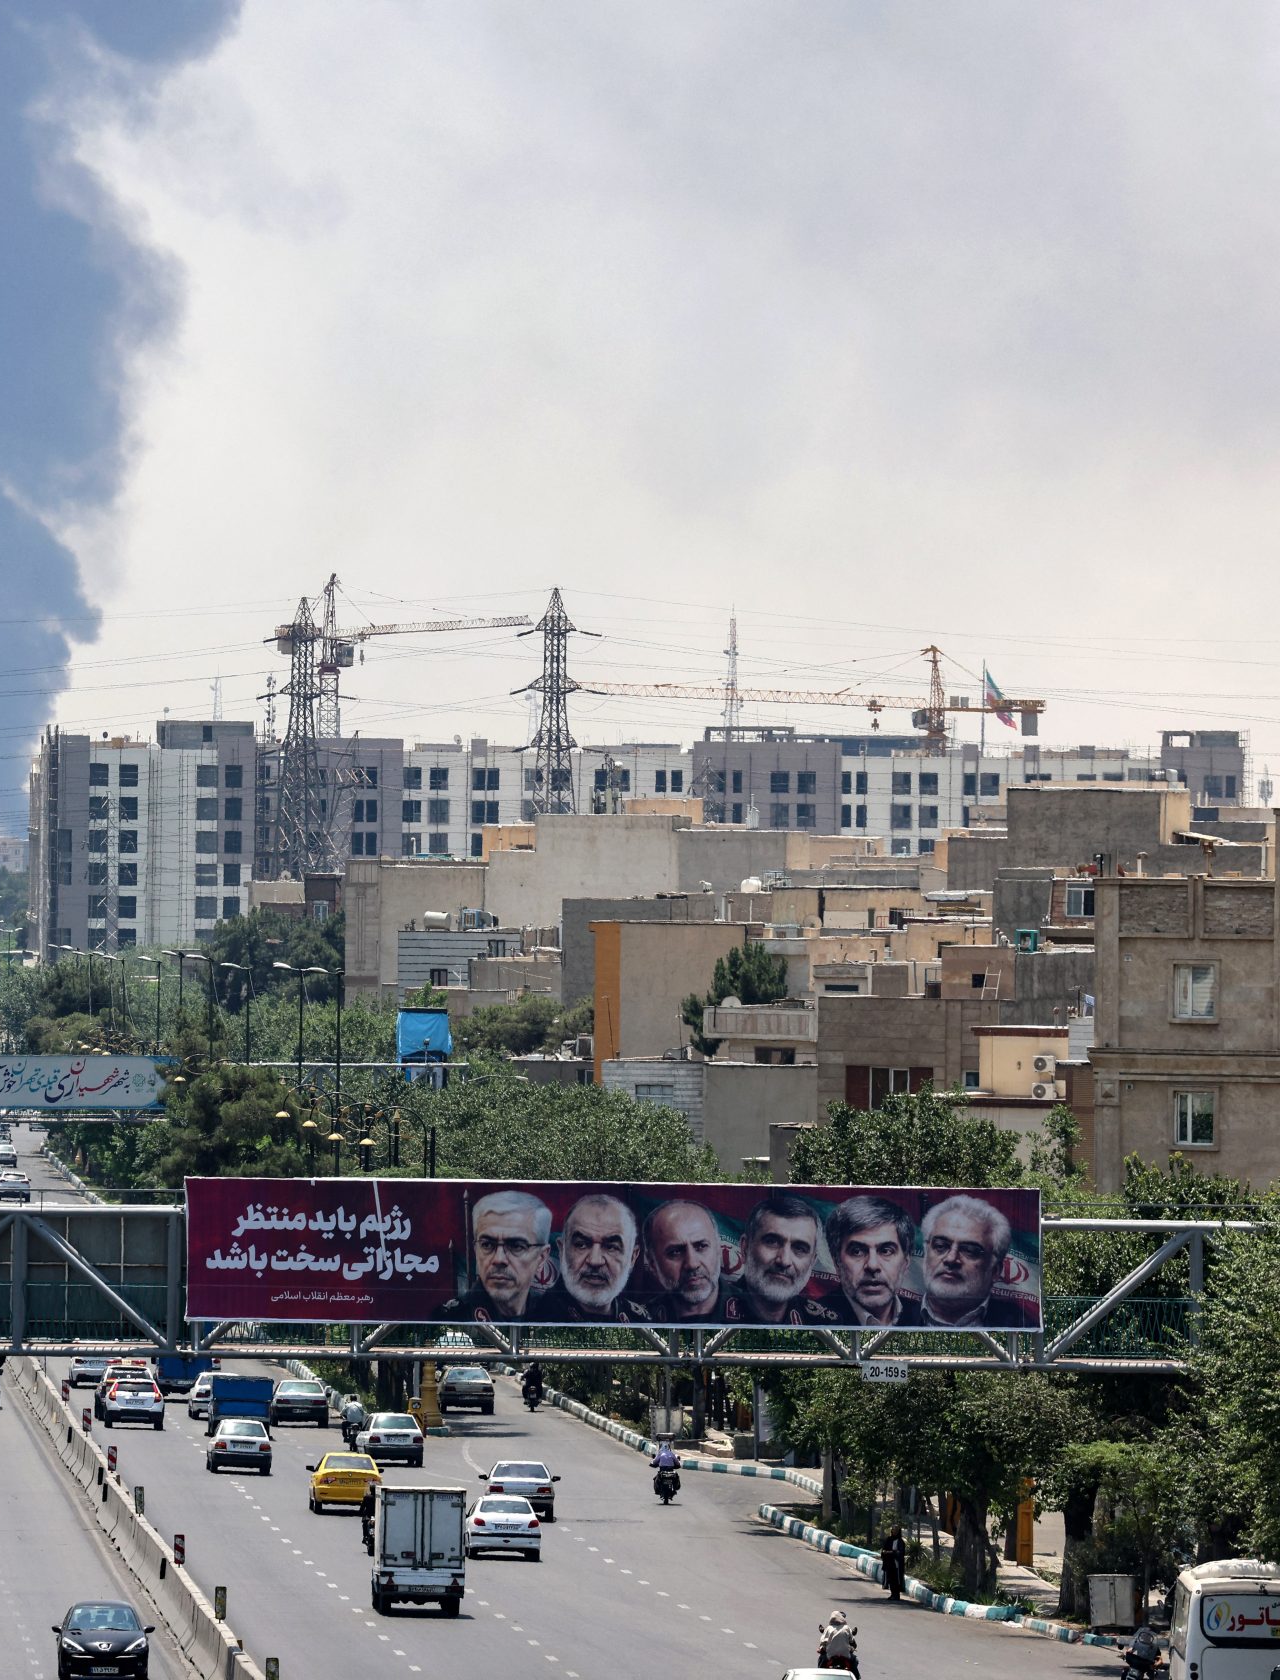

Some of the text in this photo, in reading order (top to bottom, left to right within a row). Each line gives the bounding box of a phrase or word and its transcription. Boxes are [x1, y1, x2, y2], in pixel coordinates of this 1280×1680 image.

[12, 1058, 41, 1094] تهران
[99, 1069, 130, 1095] شهر
[231, 1202, 412, 1241] رژیم باید منتظر
[205, 1242, 440, 1281] مجازاتی سخت باشد
[270, 1291, 374, 1304] رهبر معظم انقلاب اسلامی
[863, 1372, 868, 1380] A
[870, 1366, 899, 1378] 20-159
[1226, 1605, 1280, 1632] اتور
